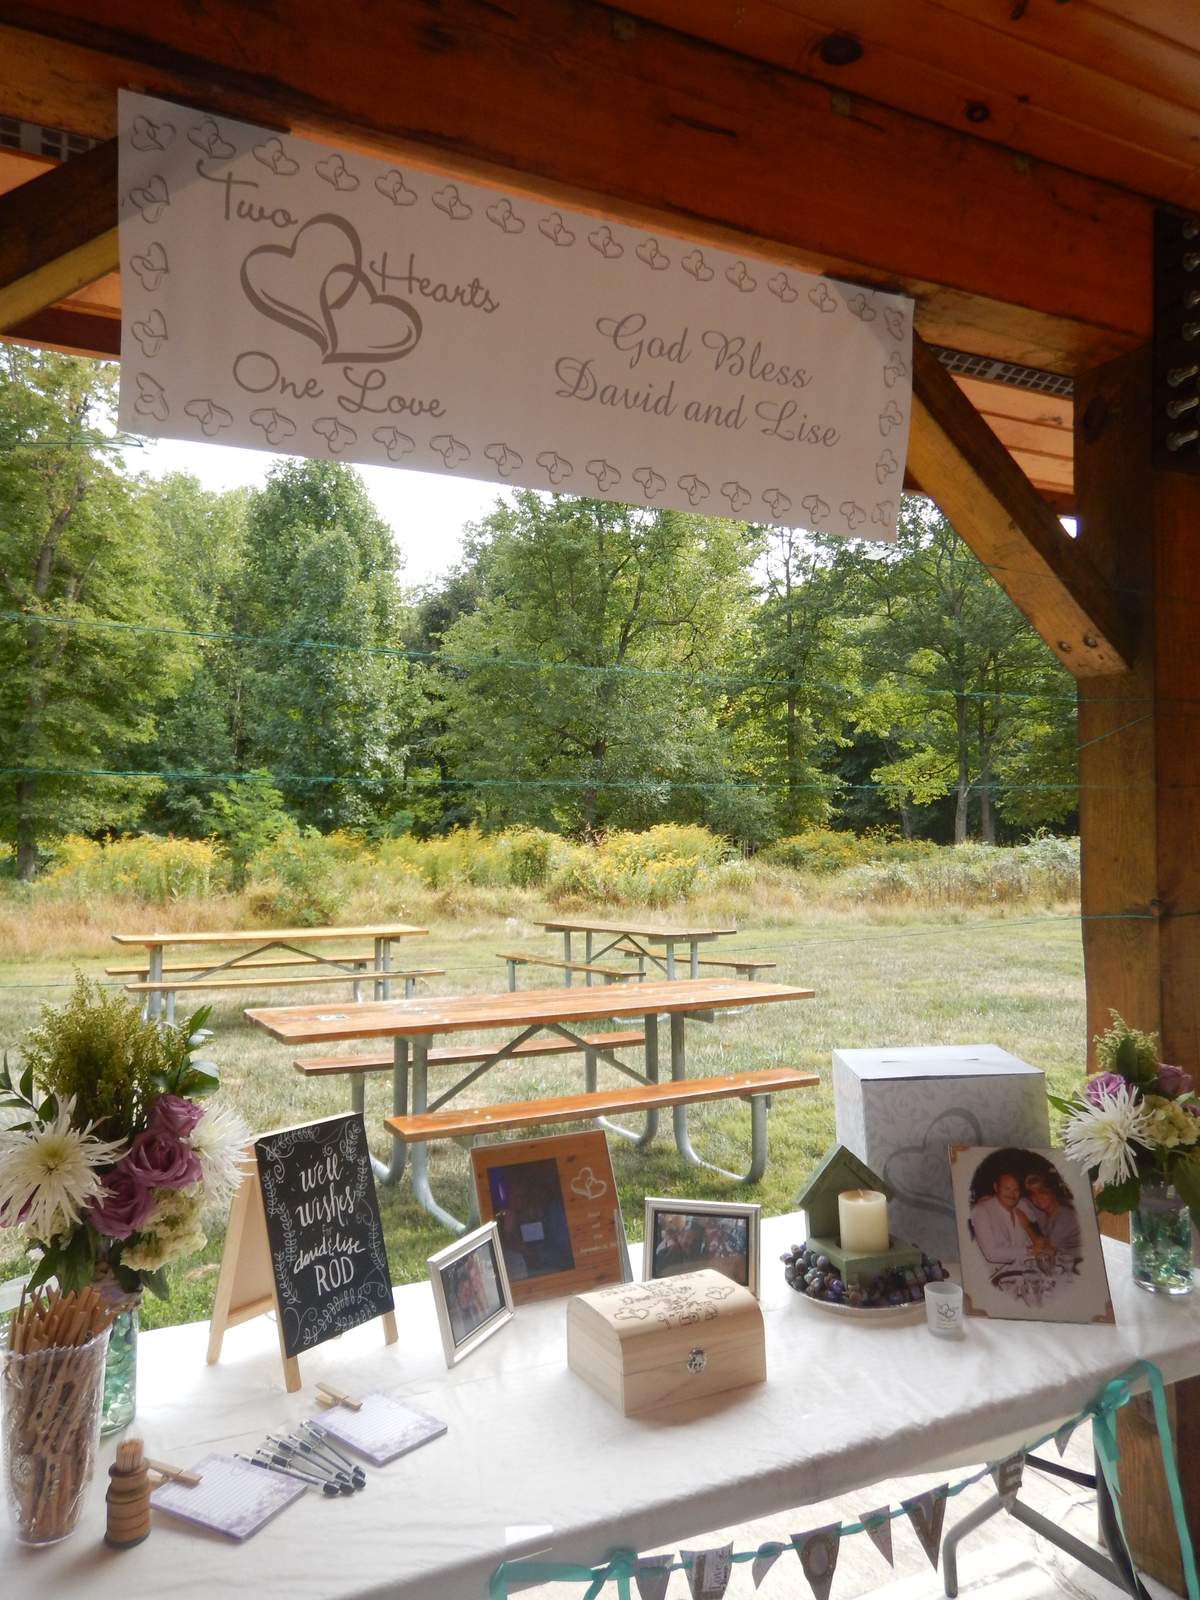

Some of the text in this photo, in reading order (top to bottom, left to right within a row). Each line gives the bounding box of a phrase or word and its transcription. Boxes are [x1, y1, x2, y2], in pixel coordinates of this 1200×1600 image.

[197, 159, 299, 229] Two
[370, 251, 500, 314] Hearts
[596, 313, 813, 390] God Bless
[233, 351, 447, 418] One Love
[555, 356, 841, 448] David and Lise
[295, 1182, 357, 1227] wishes
[299, 1153, 343, 1192] well
[314, 1256, 354, 1297] ROD
